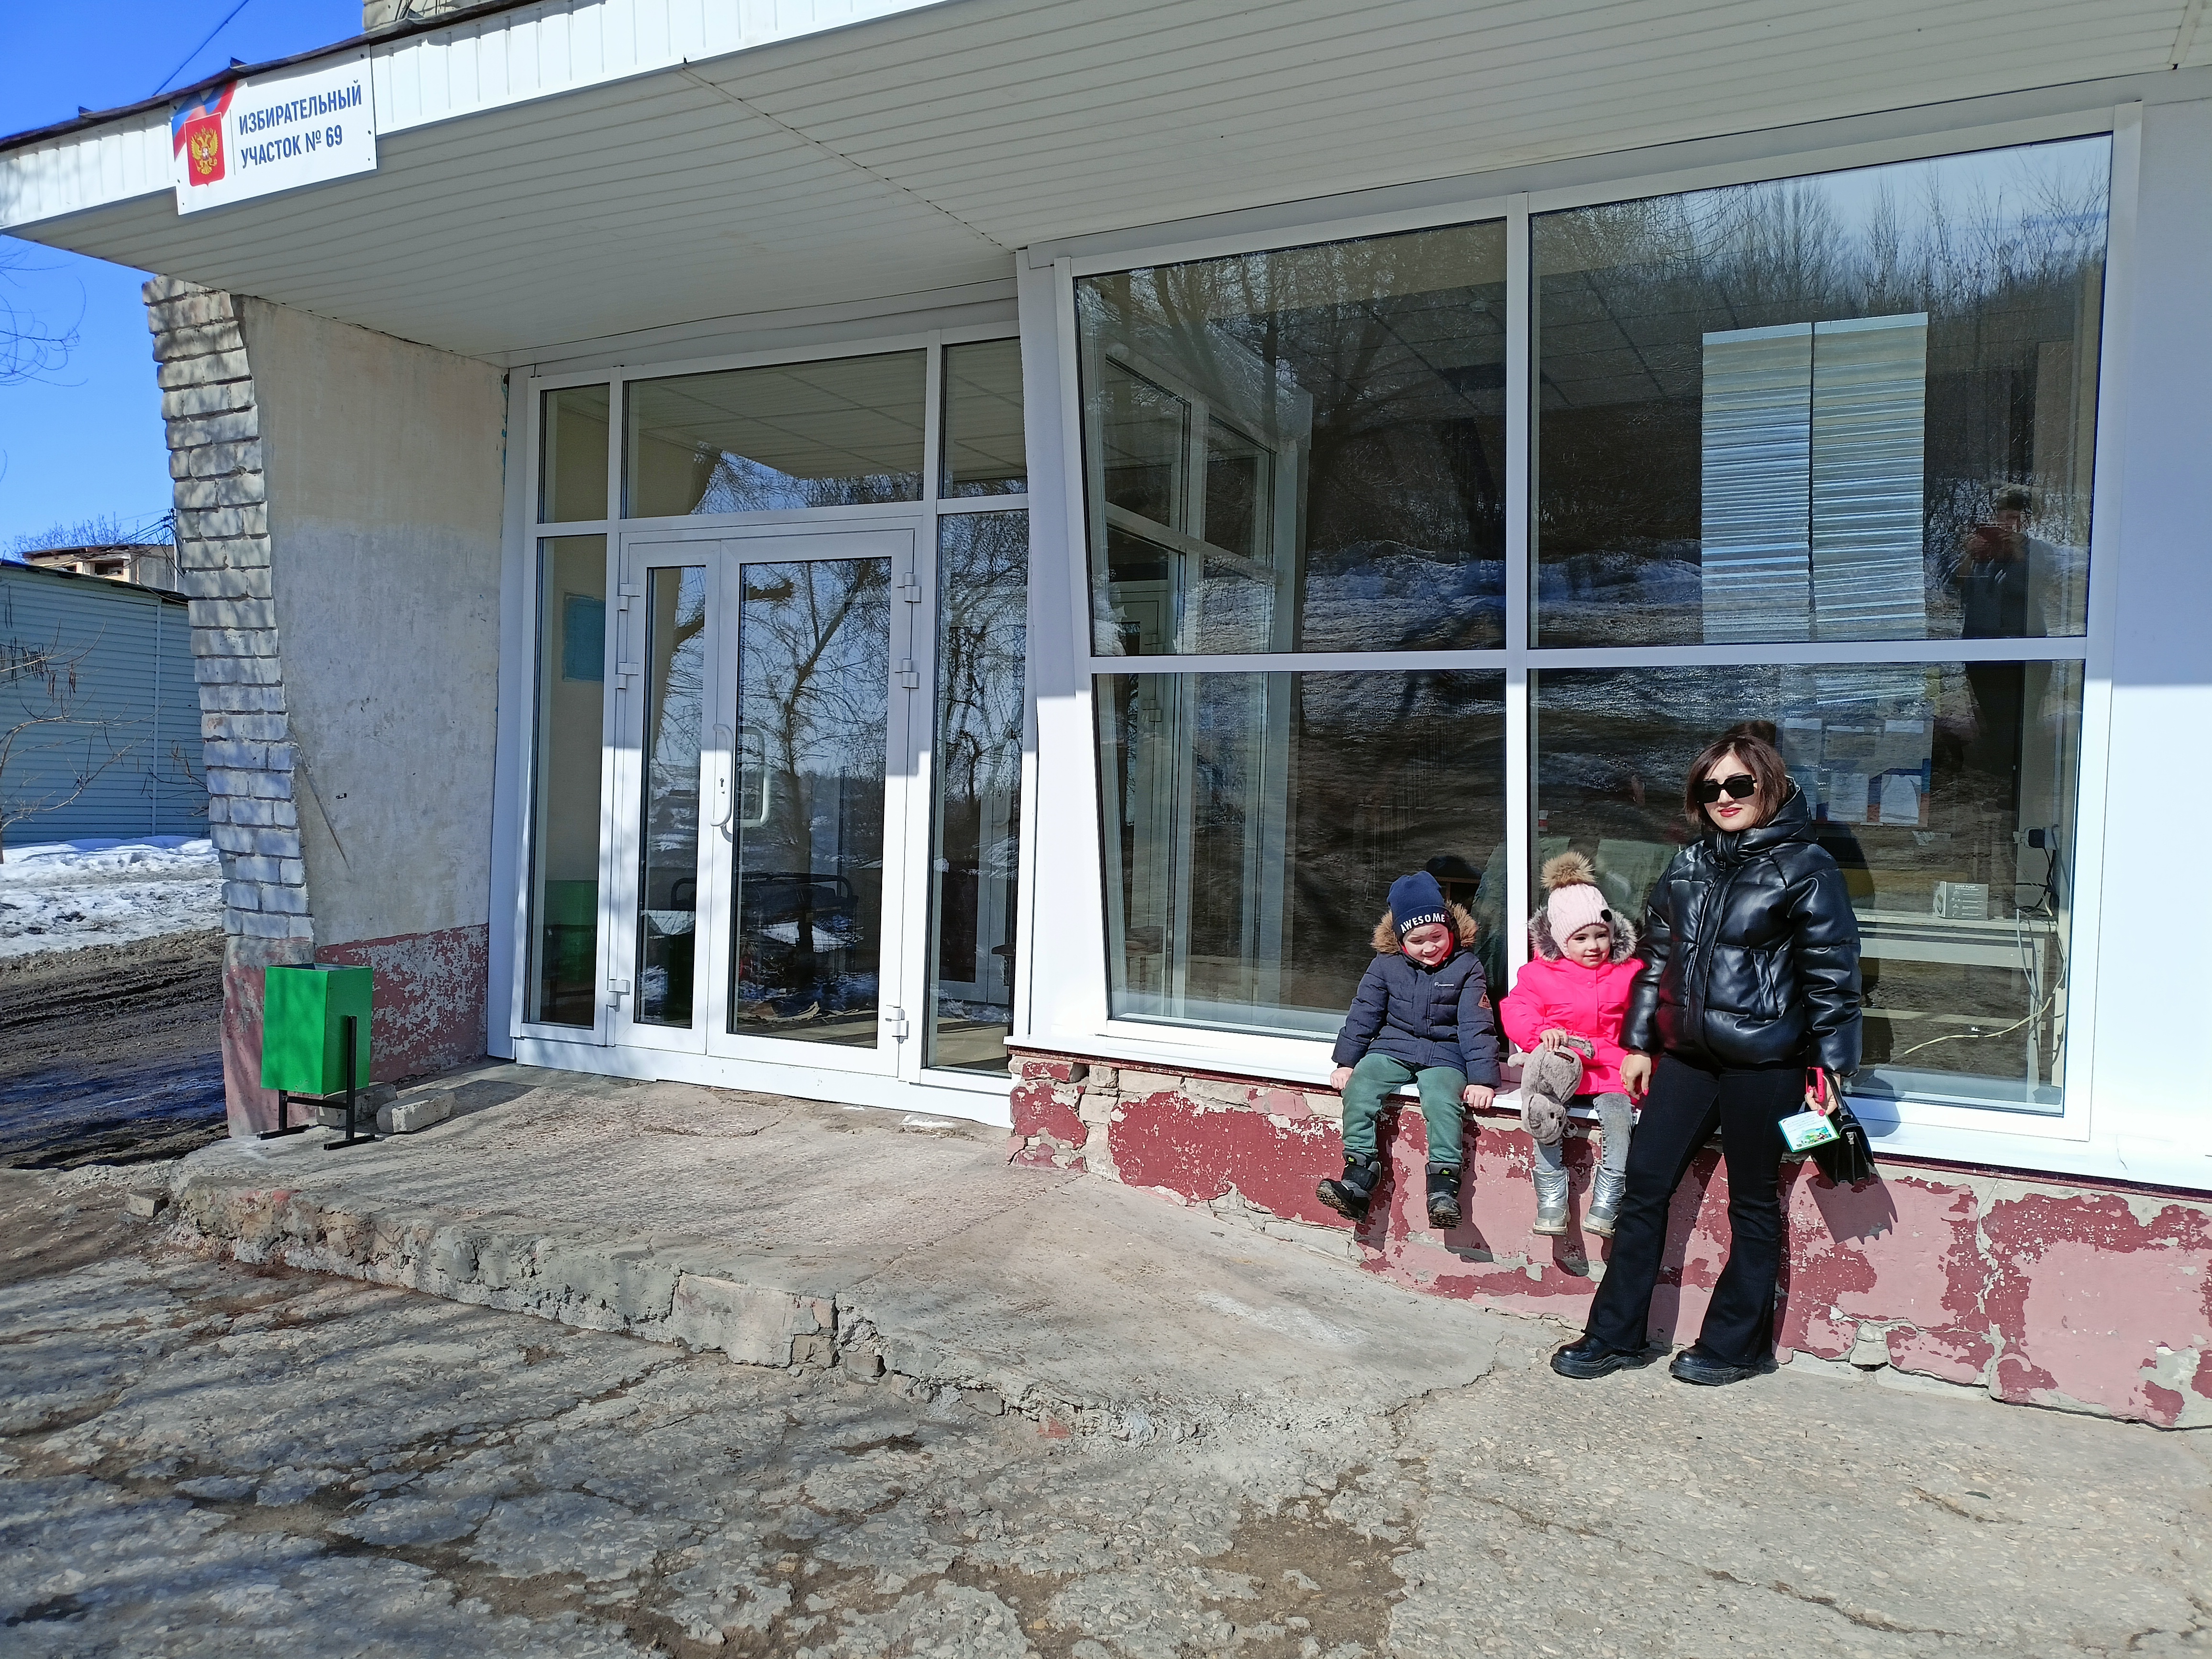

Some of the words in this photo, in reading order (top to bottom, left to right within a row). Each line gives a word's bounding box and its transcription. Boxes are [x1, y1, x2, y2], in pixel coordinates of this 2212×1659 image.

[239, 79, 362, 135] ИЗБИРАТЕЛЬНЫЙ
[241, 135, 302, 169] УЧАСТОК
[305, 130, 322, 153] №
[326, 125, 343, 148] 69
[1400, 913, 1445, 933] AWESOME
